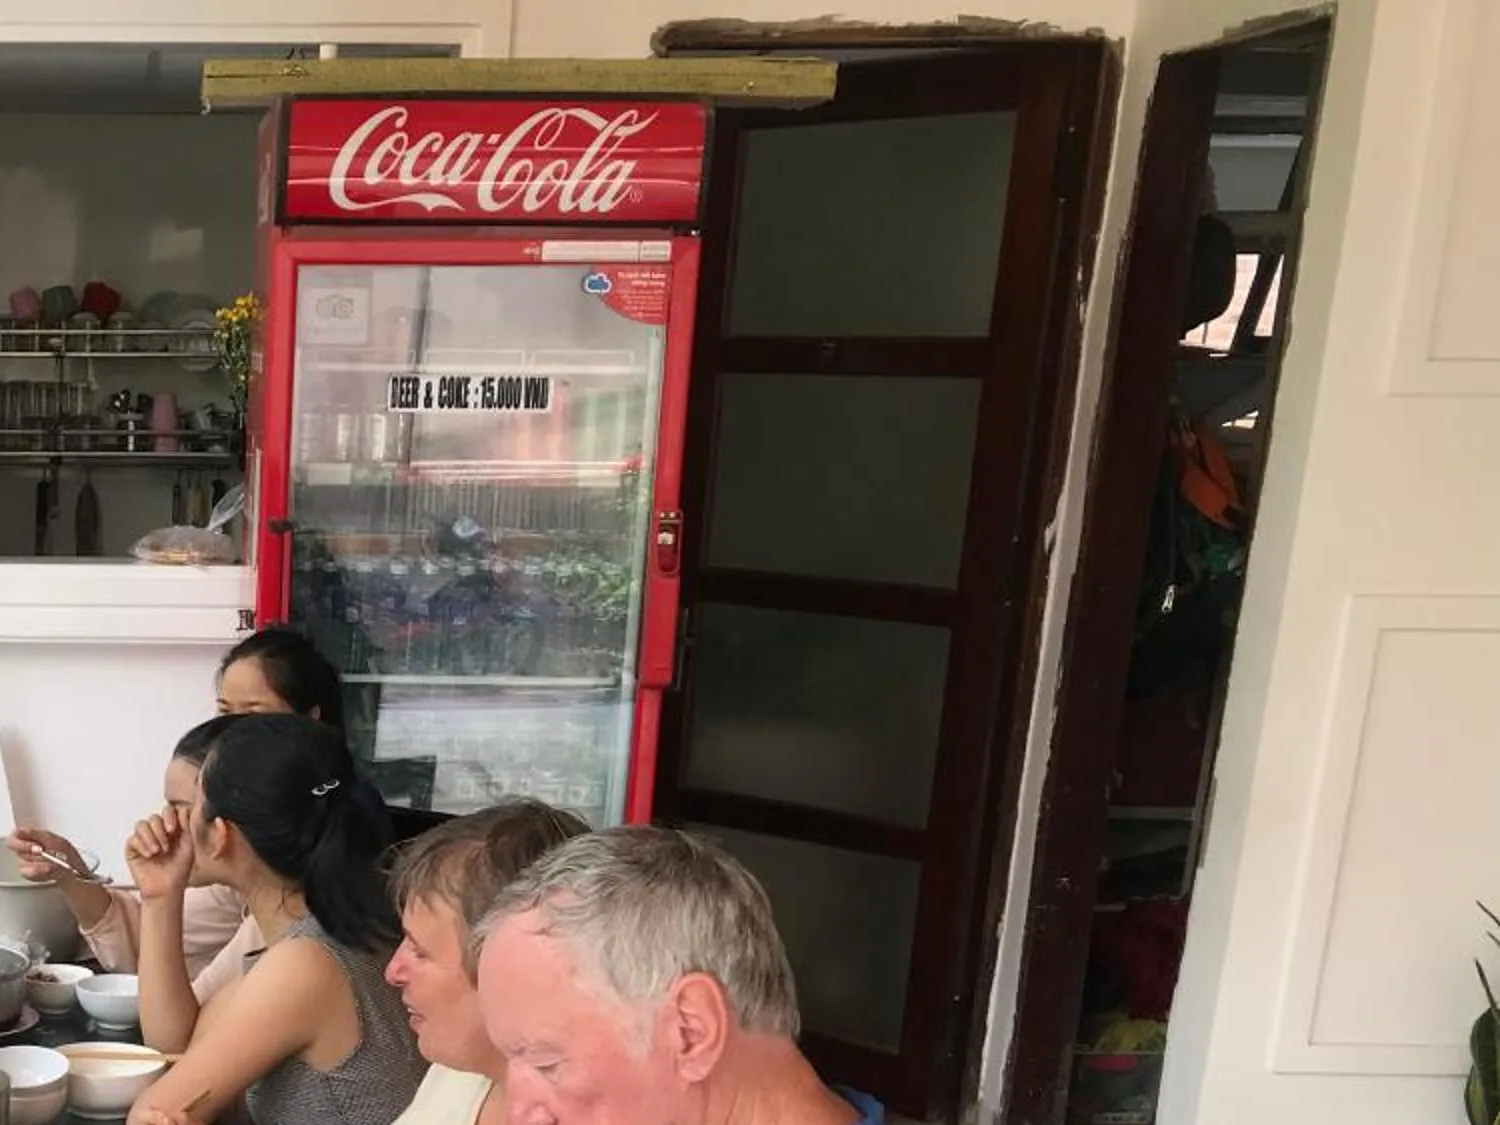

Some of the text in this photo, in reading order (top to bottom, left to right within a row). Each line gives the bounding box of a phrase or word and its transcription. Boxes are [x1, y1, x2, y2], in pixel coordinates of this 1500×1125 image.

[328, 105, 660, 213] Coca-Cola
[391, 376, 420, 409] BEER
[424, 381, 434, 409] &
[438, 376, 471, 409] COKE
[481, 376, 522, 409] 15.000
[523, 376, 549, 409] VND
